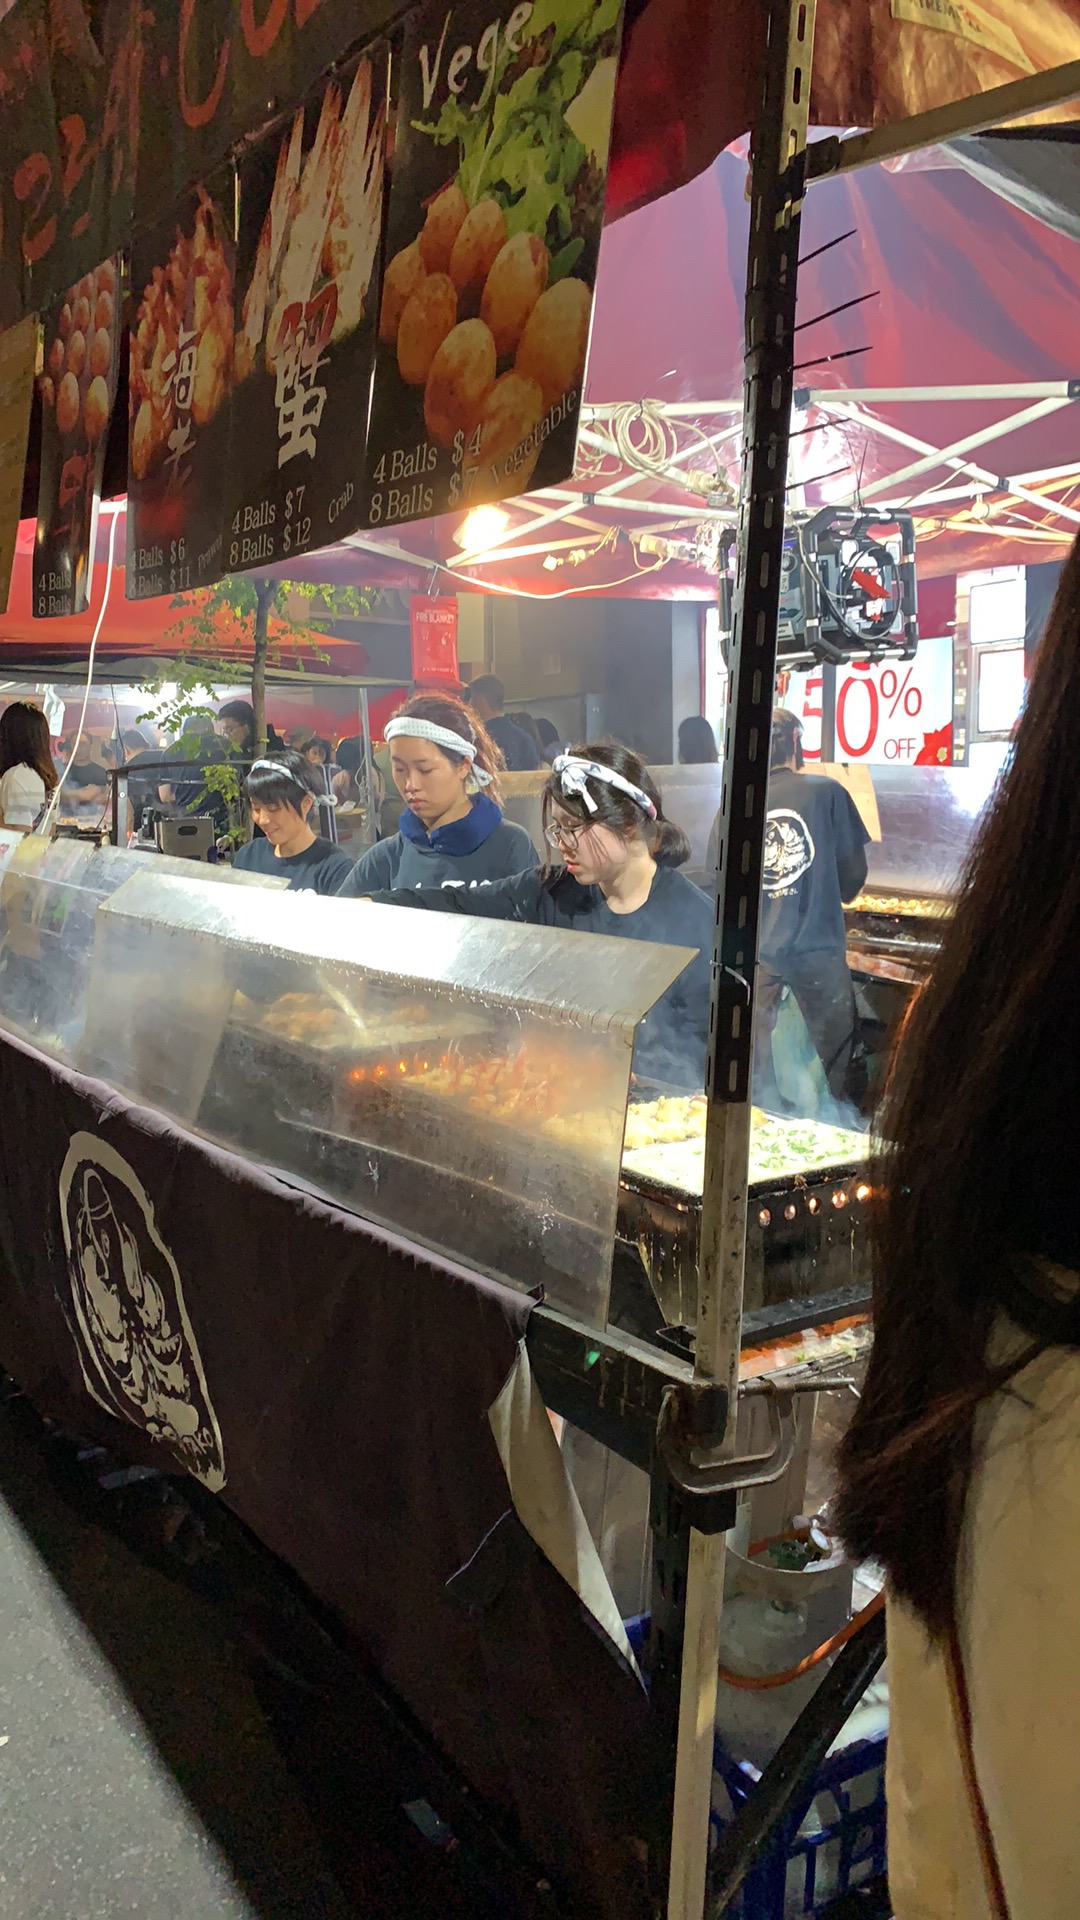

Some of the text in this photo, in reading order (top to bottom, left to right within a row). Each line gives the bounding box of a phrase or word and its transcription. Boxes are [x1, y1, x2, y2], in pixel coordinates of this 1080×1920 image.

[419, 2, 533, 112] Vege
[489, 389, 578, 486] Vegetable
[373, 453, 386, 485] 4
[389, 442, 438, 482] Balls
[231, 510, 241, 535] 4
[243, 500, 276, 532] Balls
[328, 482, 354, 523] Crab
[369, 493, 382, 524] 8
[385, 484, 434, 520] Balls
[139, 546, 164, 570] Balls
[229, 541, 239, 566] 8
[241, 533, 274, 563] Balls
[39, 571, 72, 591] 4 Balls
[129, 578, 137, 599] 8
[138, 574, 163, 596] Balls
[39, 595, 72, 615] 8 Balls
[416, 611, 455, 625] FIRE BLANKET
[884, 738, 917, 760] OFF
